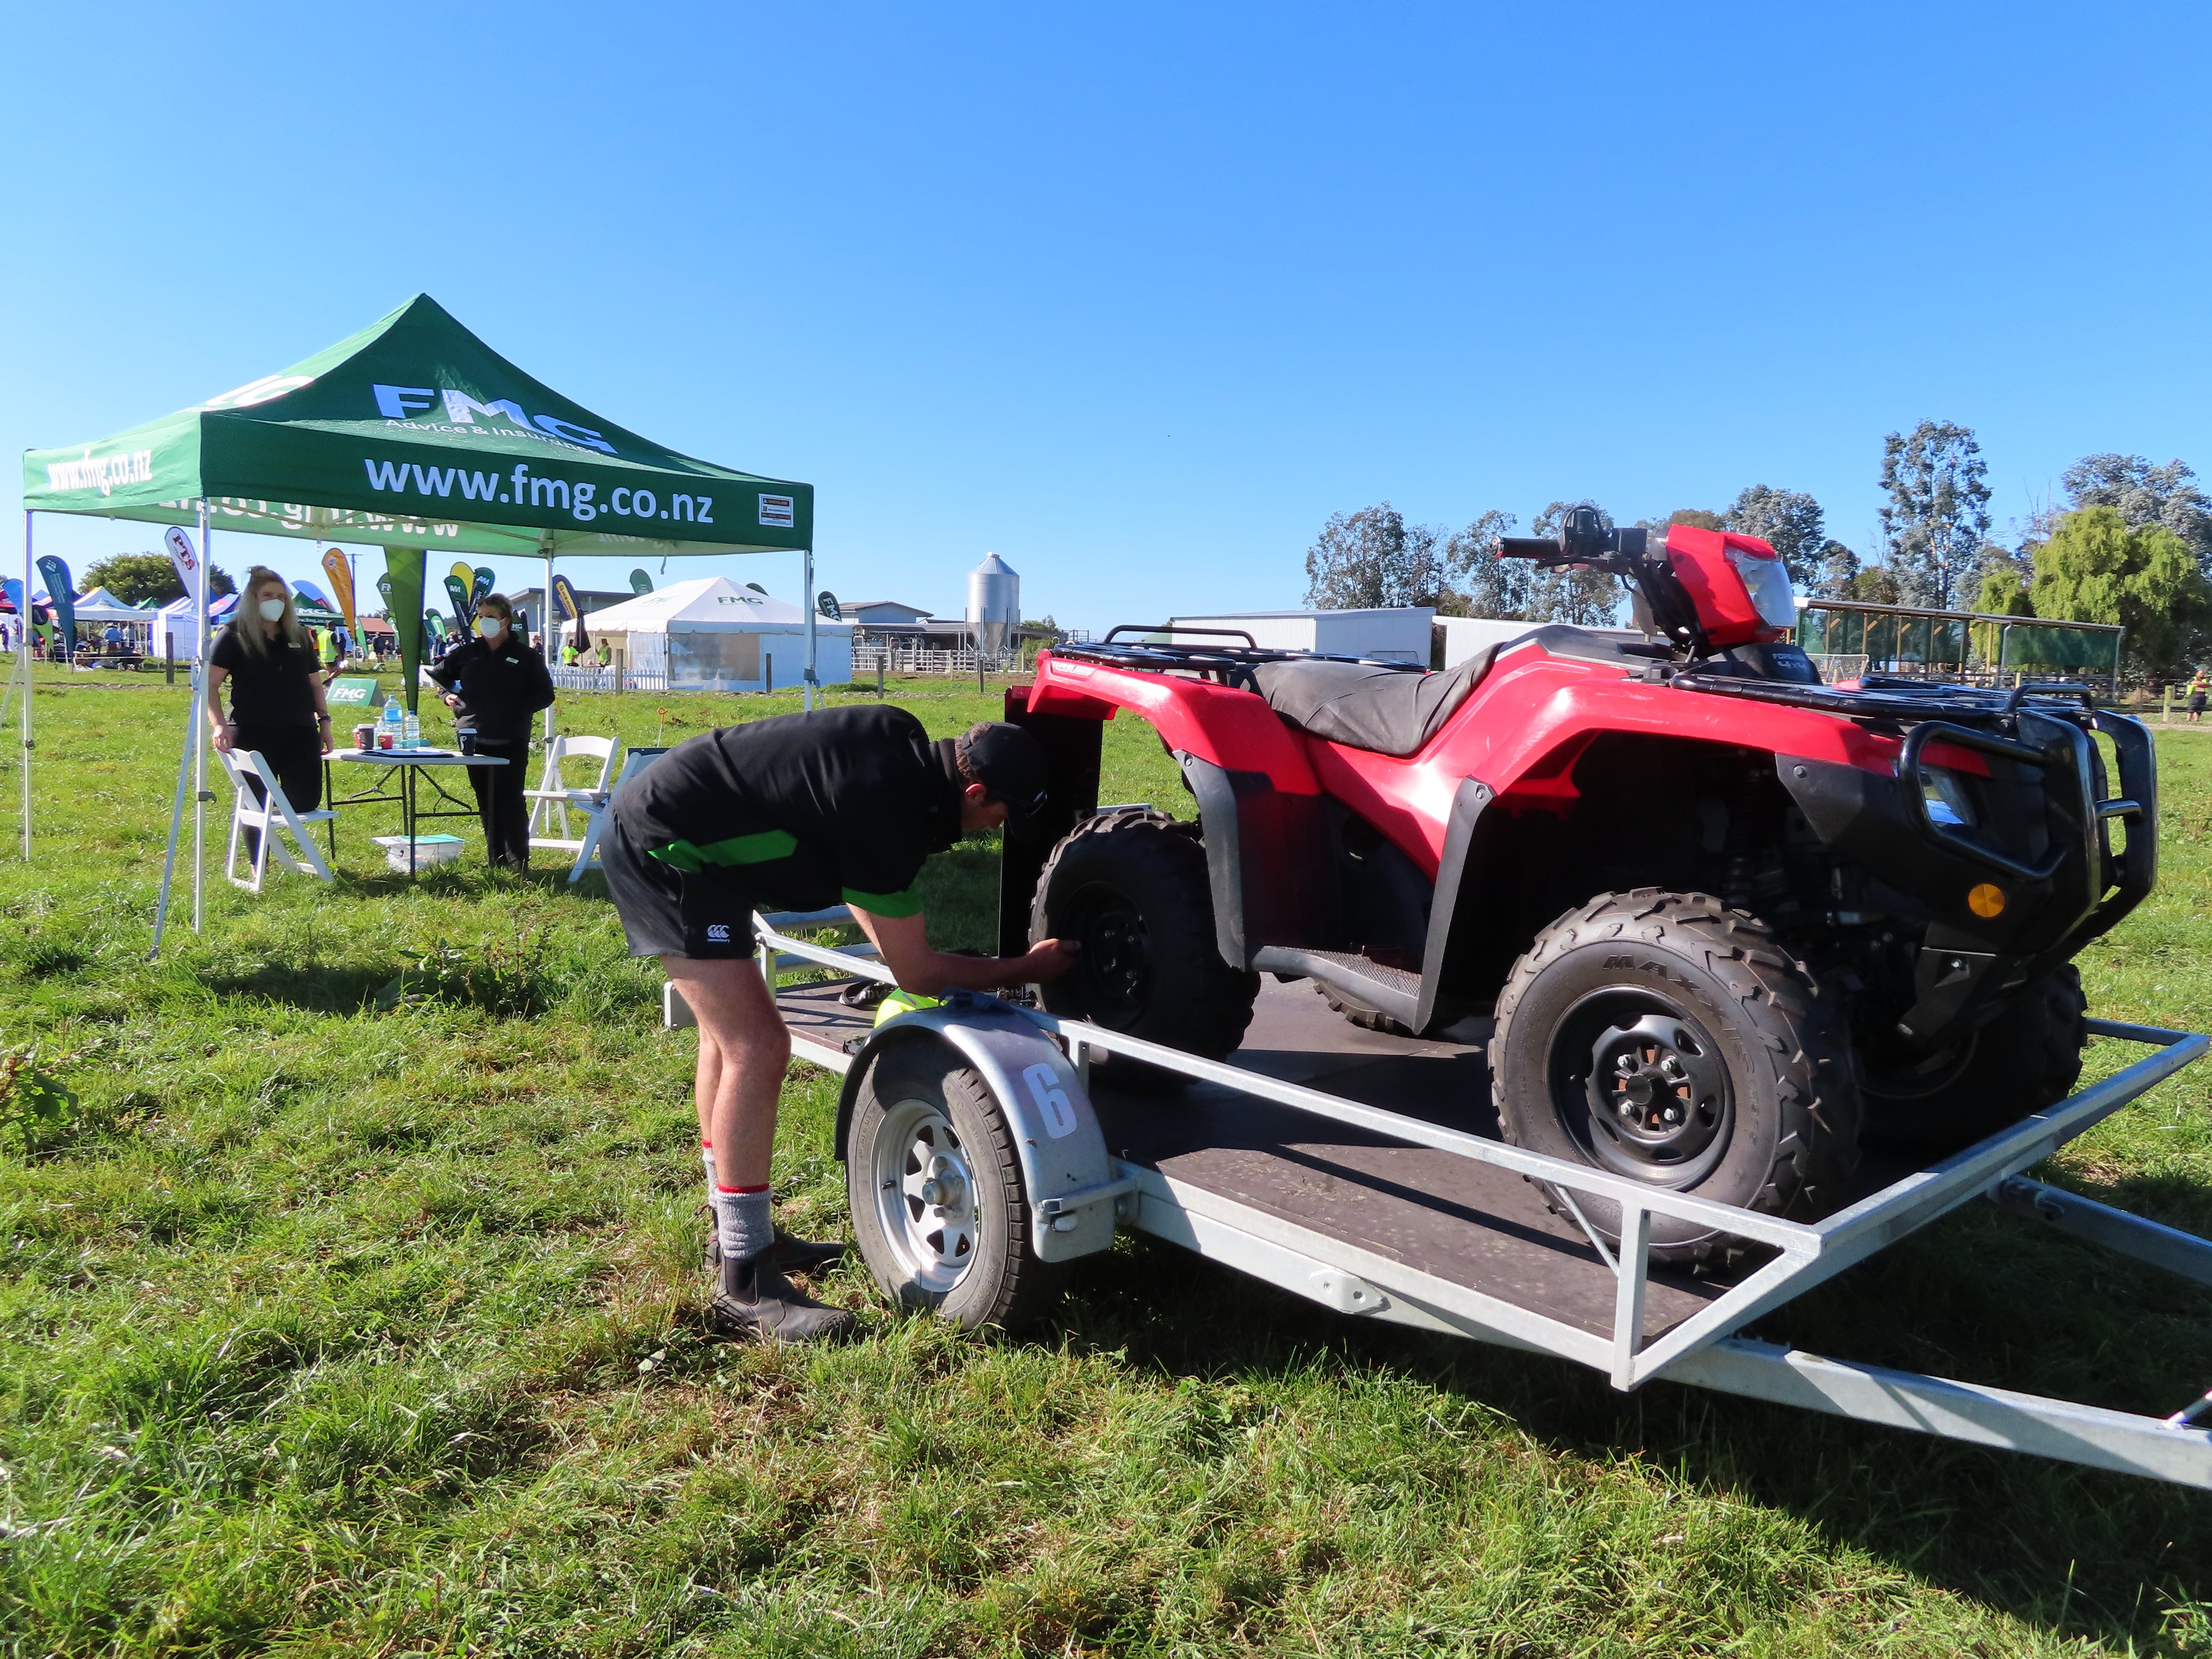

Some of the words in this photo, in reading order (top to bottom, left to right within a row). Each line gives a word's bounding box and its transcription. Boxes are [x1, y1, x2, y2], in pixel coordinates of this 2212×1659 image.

[373, 384, 618, 454] FMG
[385, 419, 467, 435] Advice
[472, 425, 489, 435] &
[492, 427, 601, 455] Insurance
[48, 448, 152, 496] www.fmg.co.nz
[364, 458, 714, 524] www.fmg.co.nz
[717, 597, 764, 605] FMG
[333, 688, 367, 699] FMG
[1603, 955, 1755, 1073] MAXXIS
[1022, 1062, 1077, 1139] 6
